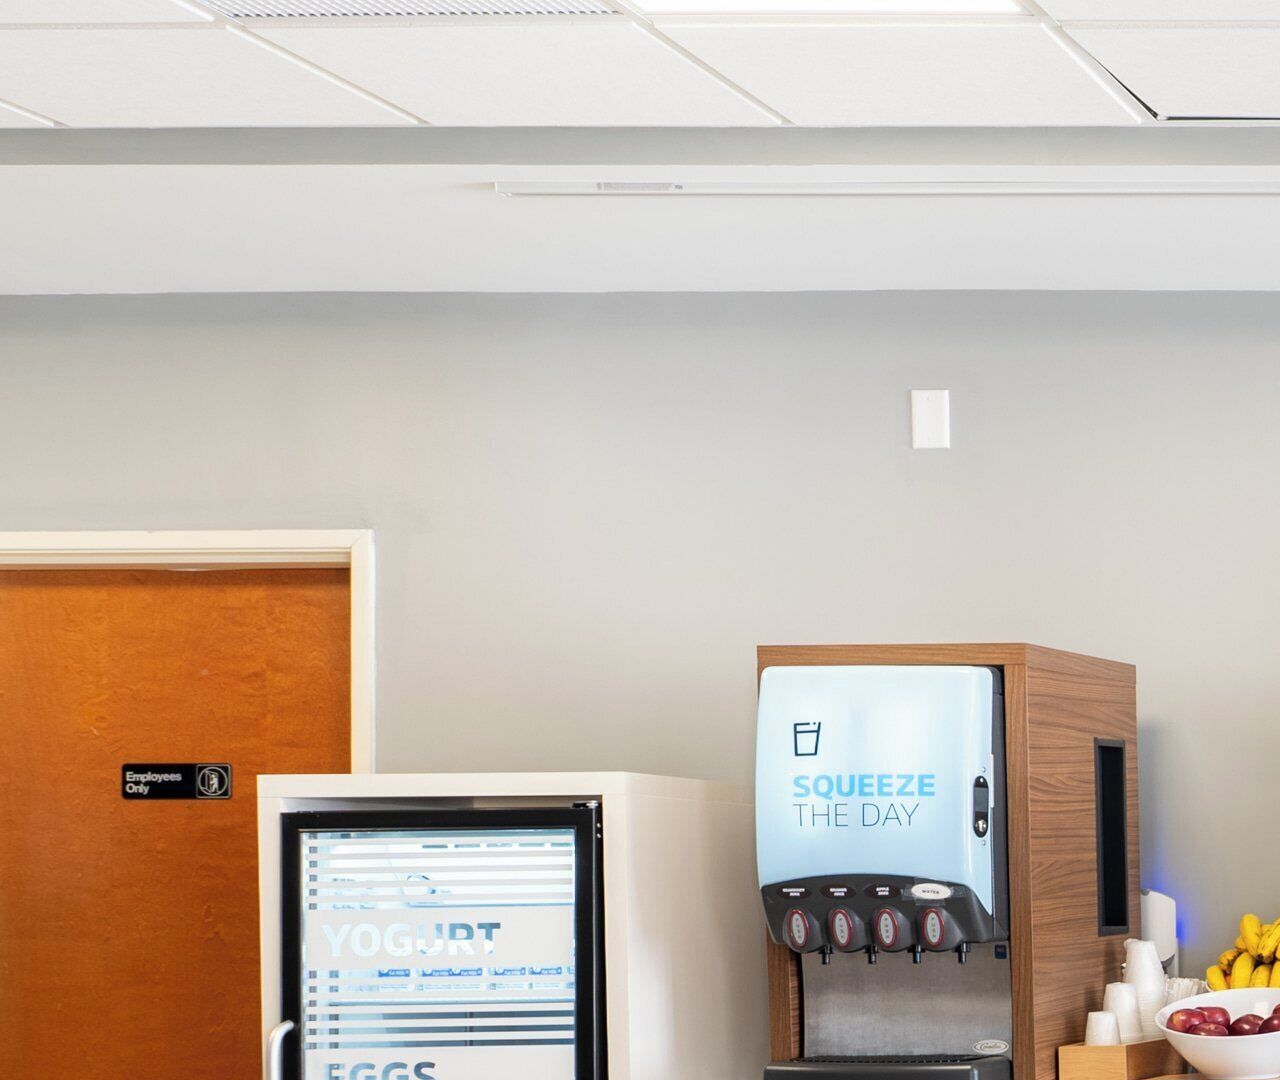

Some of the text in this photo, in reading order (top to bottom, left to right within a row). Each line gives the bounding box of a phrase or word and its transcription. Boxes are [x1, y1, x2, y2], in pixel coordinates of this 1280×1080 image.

[125, 771, 183, 783] Employees
[125, 783, 150, 795] Only
[792, 773, 936, 800] SQUEEZE
[792, 802, 920, 827] THE DAY
[322, 922, 501, 957] YOGURT
